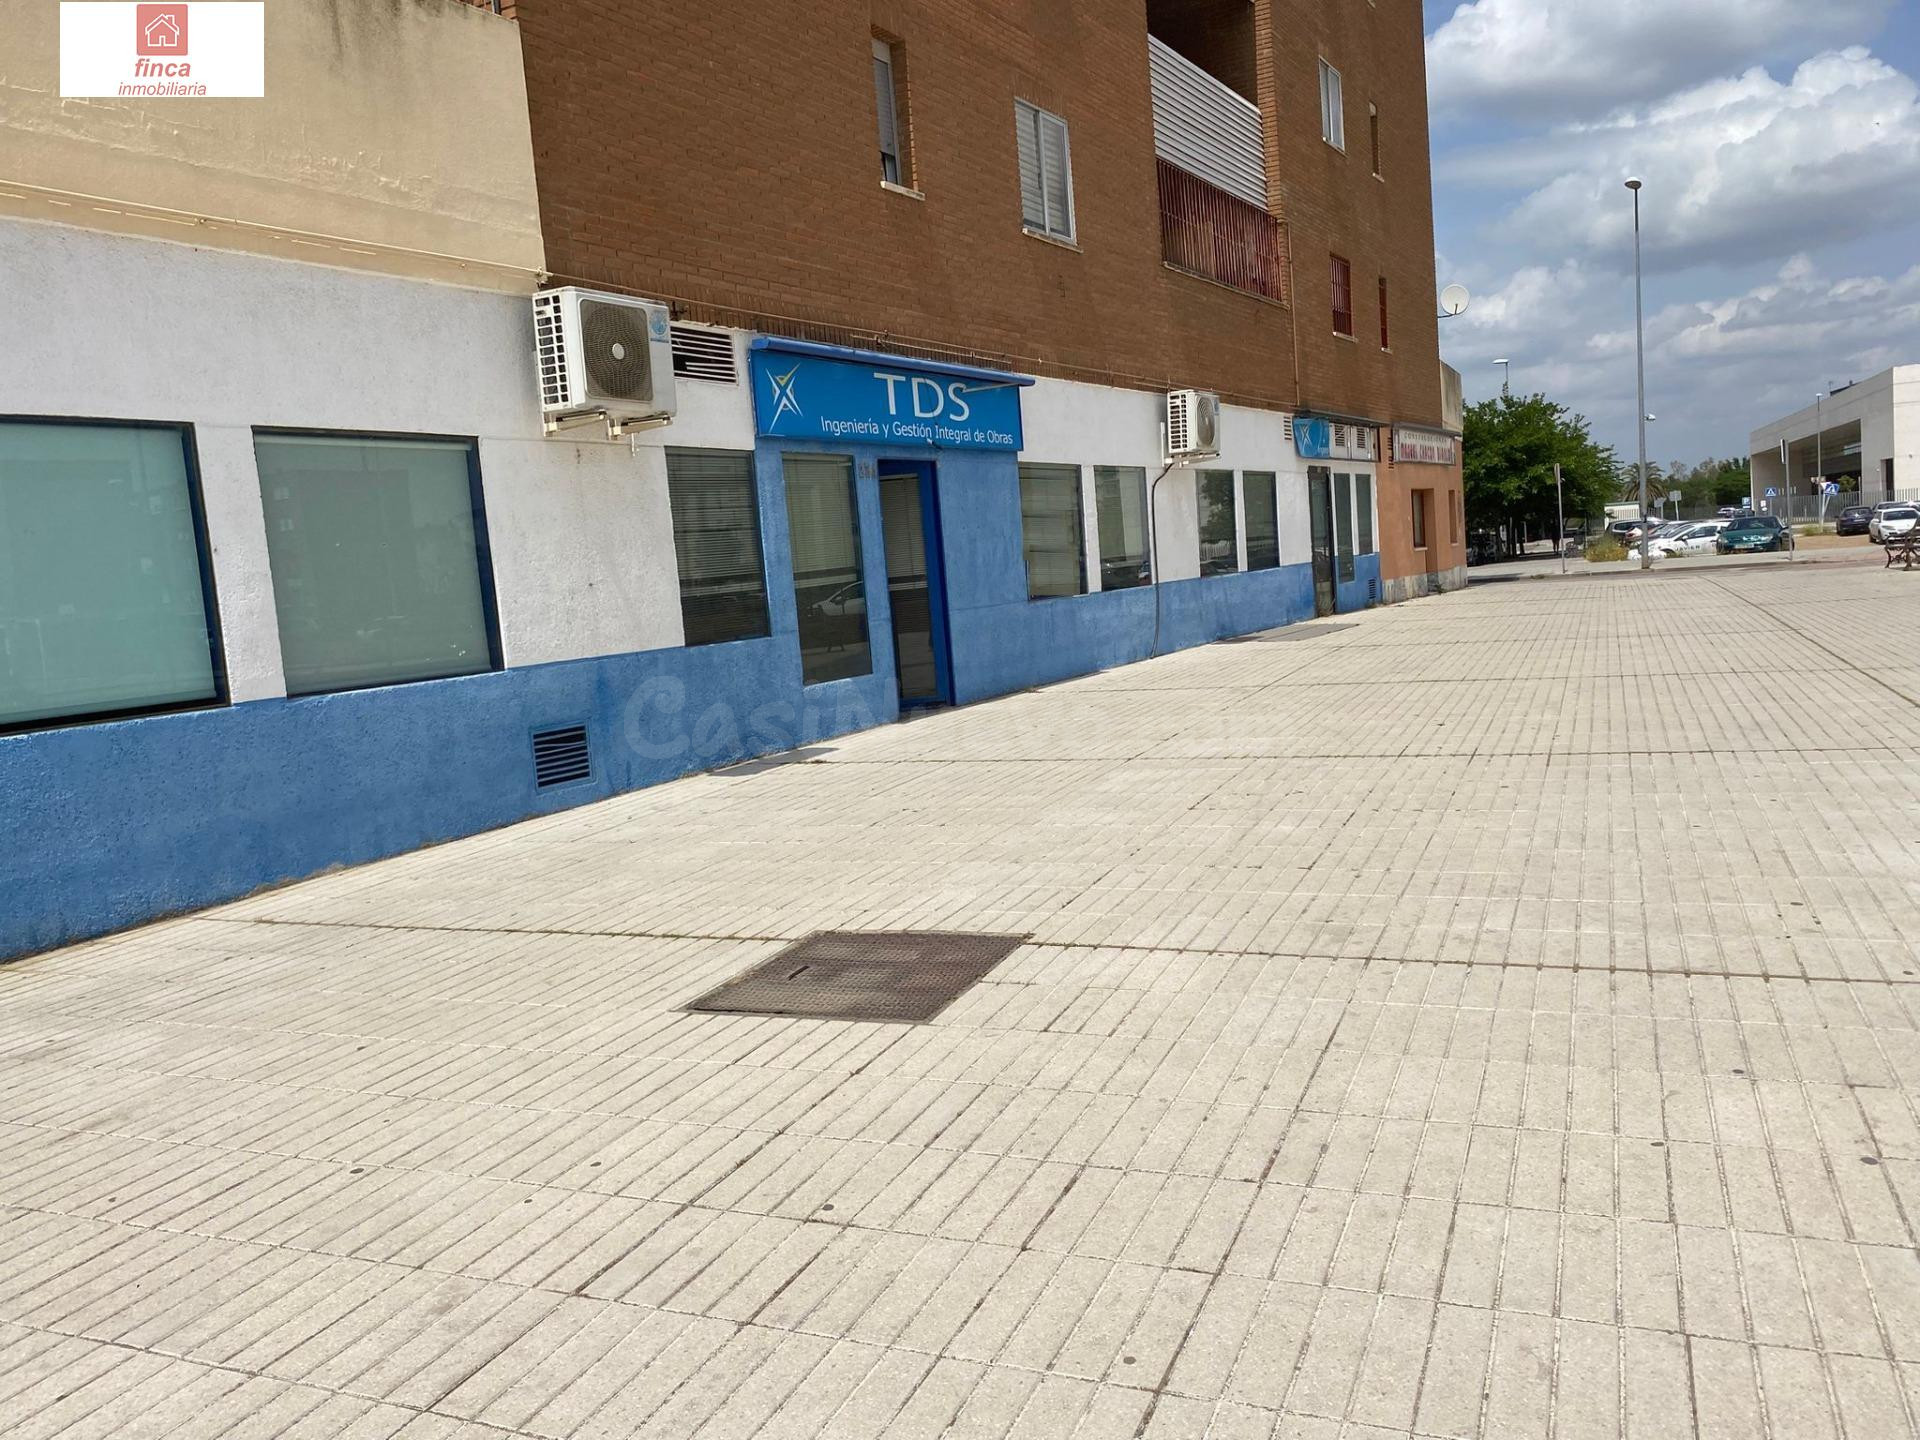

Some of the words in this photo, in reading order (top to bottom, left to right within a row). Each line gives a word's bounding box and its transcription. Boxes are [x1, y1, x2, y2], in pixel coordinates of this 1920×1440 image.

[874, 372, 970, 421] TDS
[821, 416, 879, 436] Ingeniería
[882, 423, 889, 438] y
[892, 421, 932, 439] Gestión
[935, 426, 971, 444] Integral
[974, 429, 985, 441] de
[987, 431, 1013, 444] Obras
